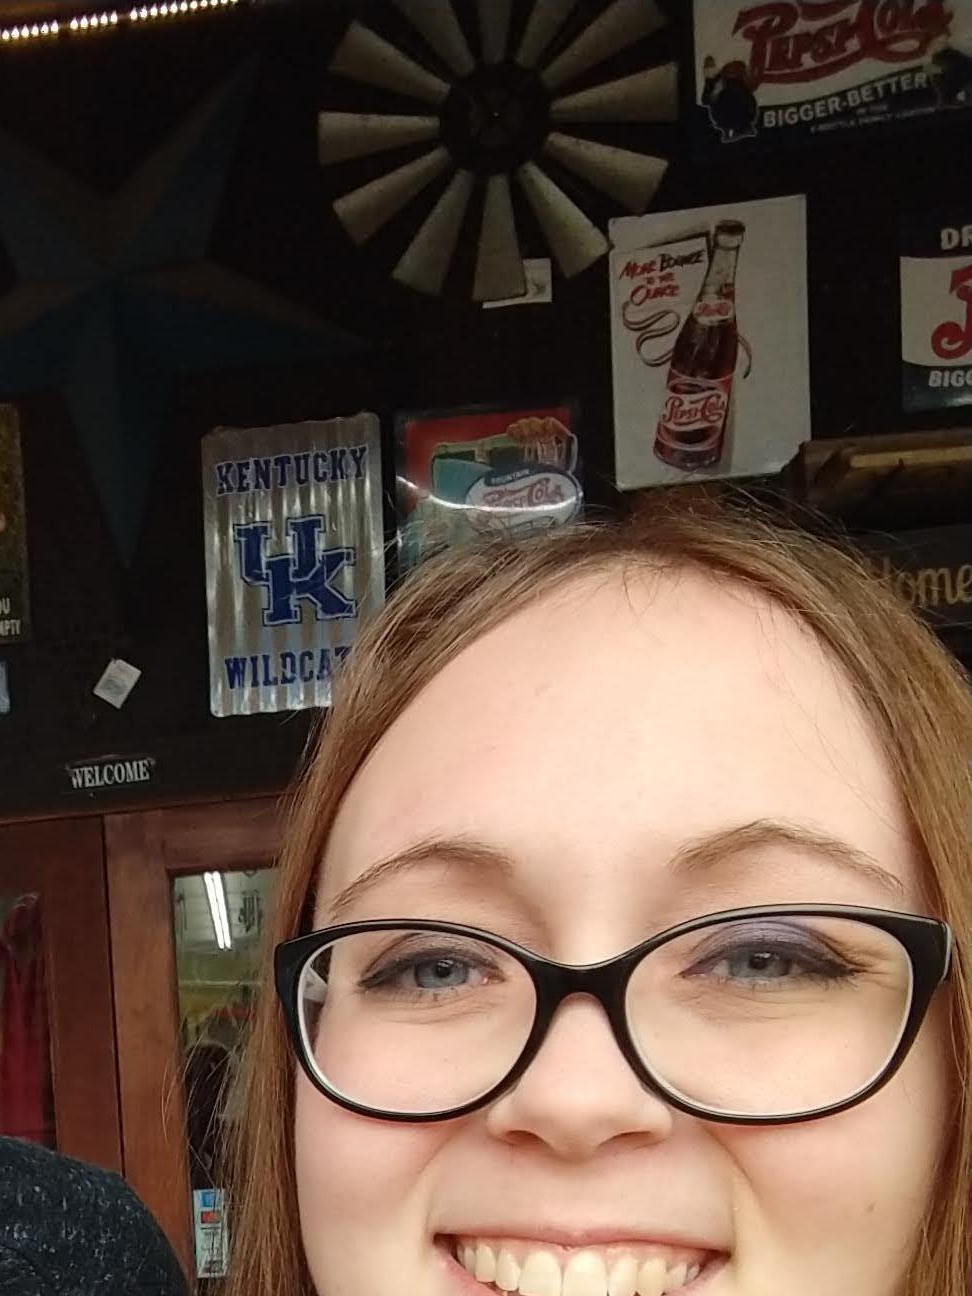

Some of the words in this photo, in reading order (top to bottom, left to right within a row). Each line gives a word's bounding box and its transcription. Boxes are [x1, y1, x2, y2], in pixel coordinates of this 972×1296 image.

[216, 446, 368, 496] KENTUCKY
[233, 514, 358, 627] UK
[71, 760, 150, 789] WELCOME
